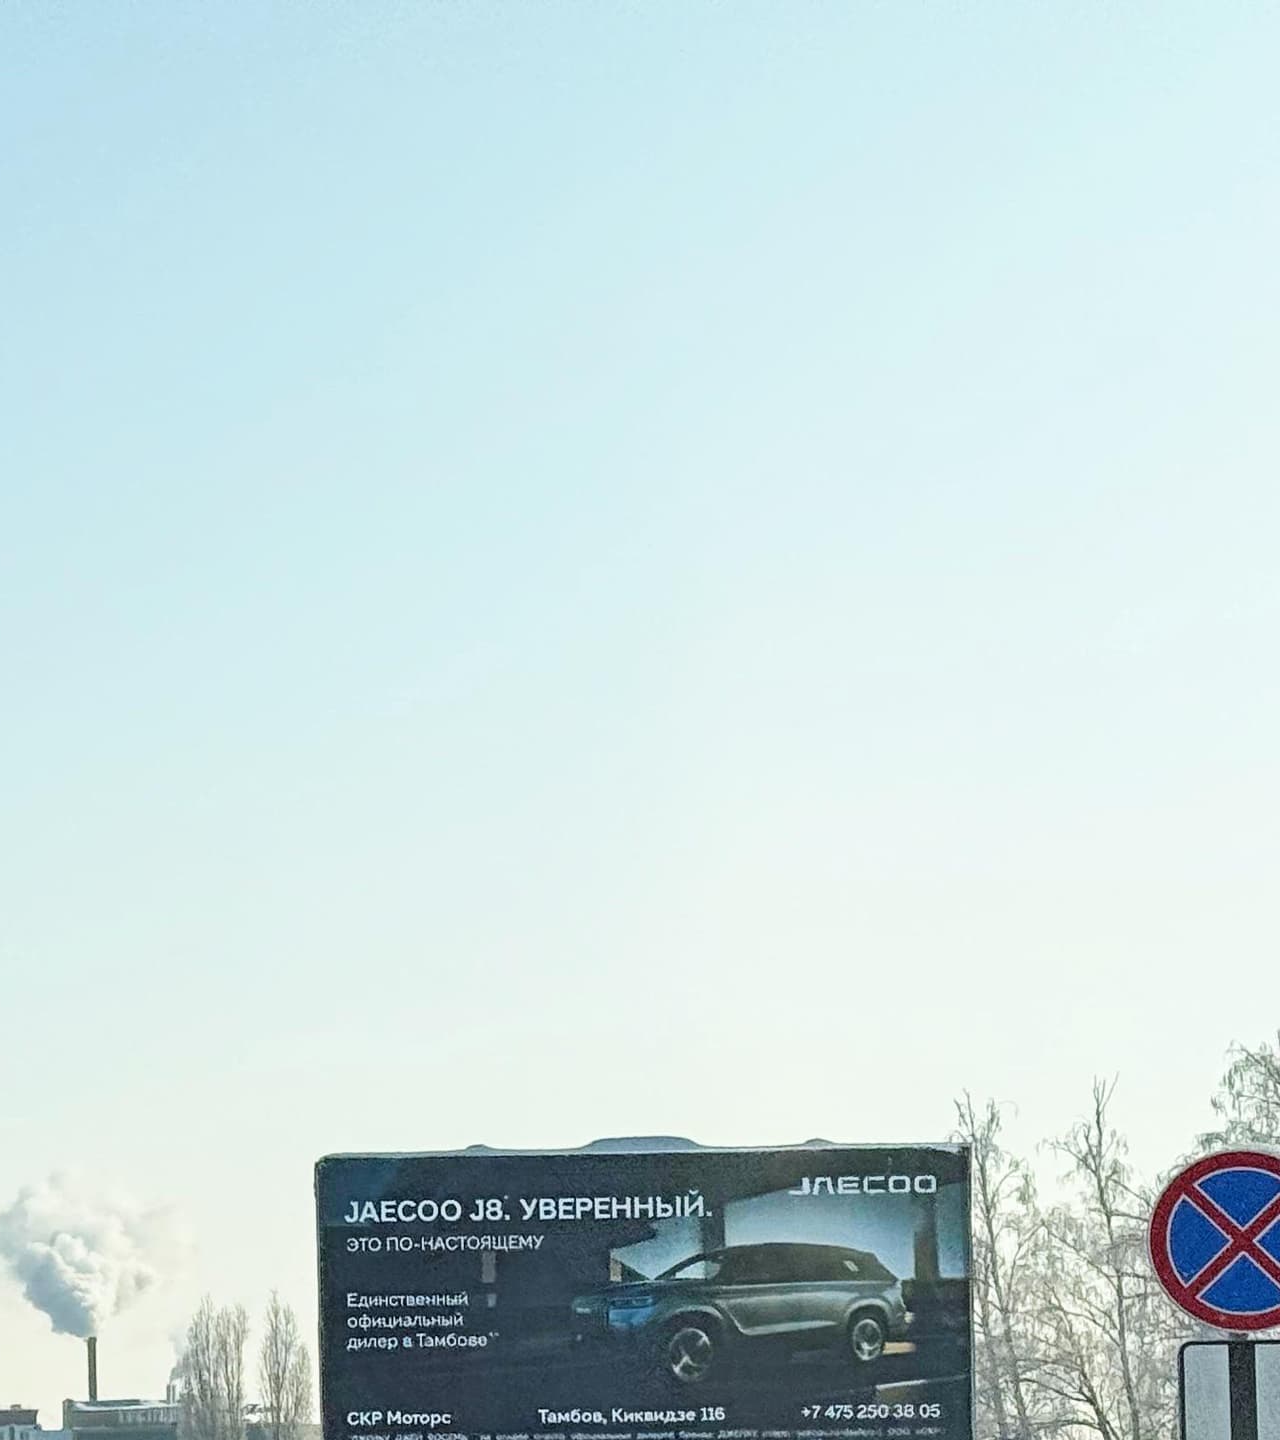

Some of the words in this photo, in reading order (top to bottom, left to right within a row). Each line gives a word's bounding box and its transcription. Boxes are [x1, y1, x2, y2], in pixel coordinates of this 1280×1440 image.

[787, 1174, 937, 1196] JAECOO
[344, 1198, 463, 1223] JAECOO
[519, 1189, 713, 1221] УВЕРЕННЫЙ.
[346, 1237, 382, 1252] ЭТО
[386, 1234, 545, 1253] ПО-НАСТОЯЩЕМУ
[346, 1291, 470, 1309] Единственный
[347, 1312, 464, 1331] официальный
[346, 1336, 398, 1352] дилер
[402, 1336, 413, 1348] в
[347, 1411, 383, 1426] СКР
[386, 1410, 452, 1429] Моторс
[538, 1408, 607, 1425] Тамбов,
[611, 1408, 697, 1424] Киквидзе
[700, 1407, 726, 1421] 116
[801, 1404, 821, 1419] +7
[824, 1404, 854, 1419] 475
[856, 1404, 889, 1419] 250
[892, 1403, 915, 1418] 38
[919, 1403, 942, 1418] 05
